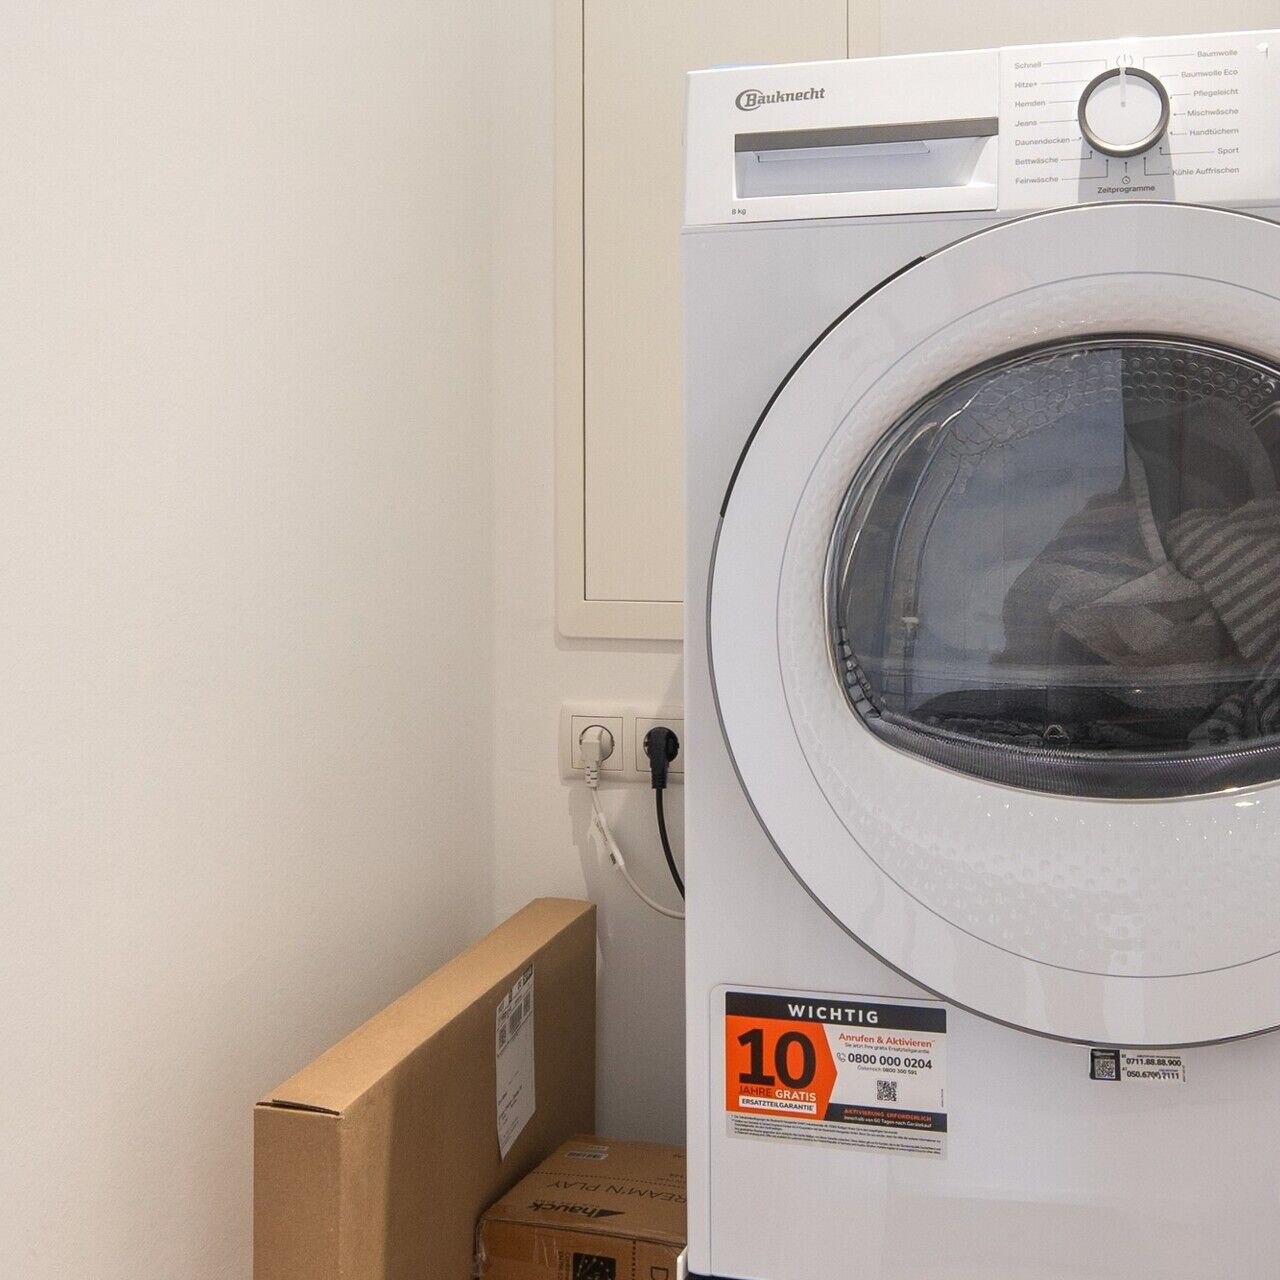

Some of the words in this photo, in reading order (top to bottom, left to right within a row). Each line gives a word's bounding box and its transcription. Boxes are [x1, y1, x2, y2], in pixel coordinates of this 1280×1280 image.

[1196, 48, 1238, 58] Baumwolle
[1014, 61, 1042, 70] Schnell
[1180, 70, 1222, 79] Baumwolle
[1223, 68, 1239, 77] Eco
[1014, 80, 1038, 89] Hitze+
[1193, 88, 1239, 98] Pflegeleicht
[735, 88, 826, 112] Bauknecht
[1014, 99, 1046, 108] Hemden
[1187, 107, 1239, 118] Mischwäsche
[1014, 119, 1038, 128] Jeans
[1014, 136, 1070, 147] Daunendecken
[1216, 147, 1239, 156] Sport
[1014, 156, 1059, 166] Bettwäsche
[1172, 168, 1194, 177] Kühle
[1195, 166, 1240, 176] Auffrischen
[1014, 175, 1059, 185] Feinwäsche
[1097, 184, 1156, 195] Zeitprogramme
[737, 208, 747, 216] kg
[788, 1003, 879, 1024] WICHTIG
[838, 1033, 875, 1044] Anrufen
[877, 1036, 884, 1044] &
[737, 1028, 817, 1089] 10
[847, 1053, 877, 1064] 0800
[879, 1056, 901, 1067] 000
[903, 1058, 933, 1070] 0204
[1126, 1058, 1181, 1067] 0711.88.88.900
[740, 1086, 772, 1097] JAHRE
[775, 1089, 817, 1101] GRATIS
[546, 1180, 601, 1192] PLAY
[606, 1184, 687, 1204] REAM'N
[527, 1200, 598, 1219] hauck
